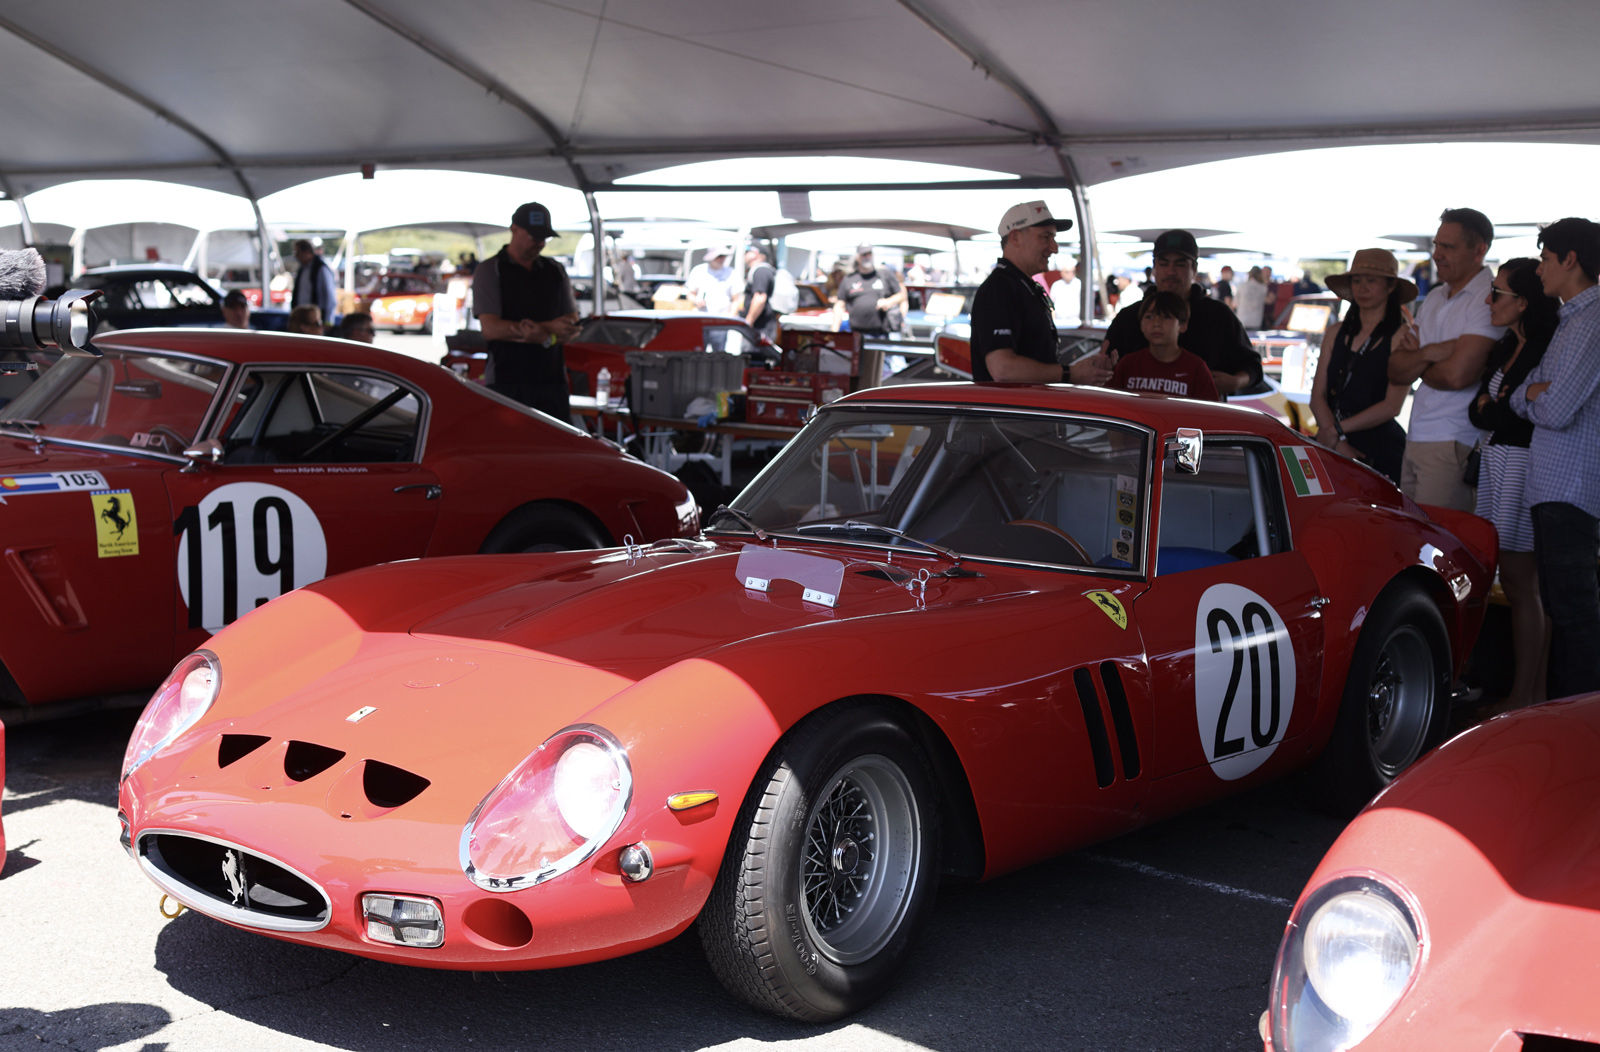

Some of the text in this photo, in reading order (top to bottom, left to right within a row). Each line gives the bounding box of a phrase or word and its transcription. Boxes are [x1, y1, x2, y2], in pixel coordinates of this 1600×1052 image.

[1126, 376, 1188, 396] STANFORD
[57, 473, 99, 487] 105
[173, 496, 295, 629] 119
[1206, 601, 1281, 759] 20
